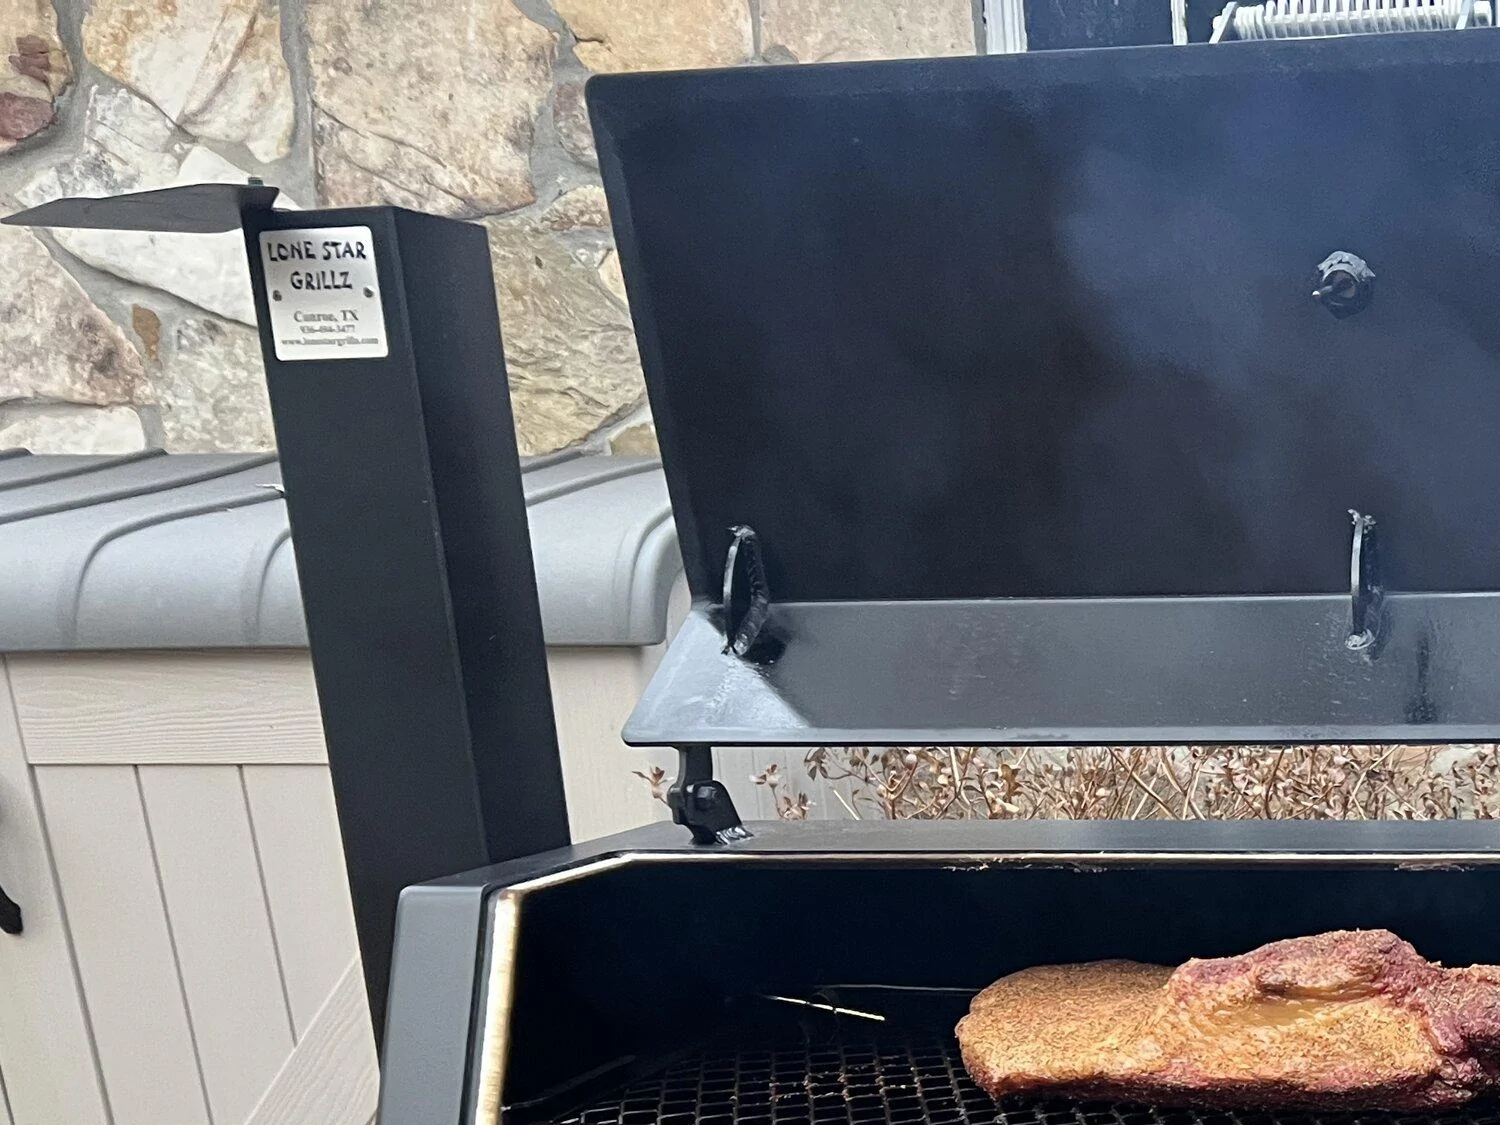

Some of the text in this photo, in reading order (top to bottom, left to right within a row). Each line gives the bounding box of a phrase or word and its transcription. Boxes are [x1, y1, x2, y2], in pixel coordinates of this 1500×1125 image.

[267, 241, 367, 262] LONE STAR
[290, 270, 353, 290] GRILLZ
[340, 309, 359, 321] TX
